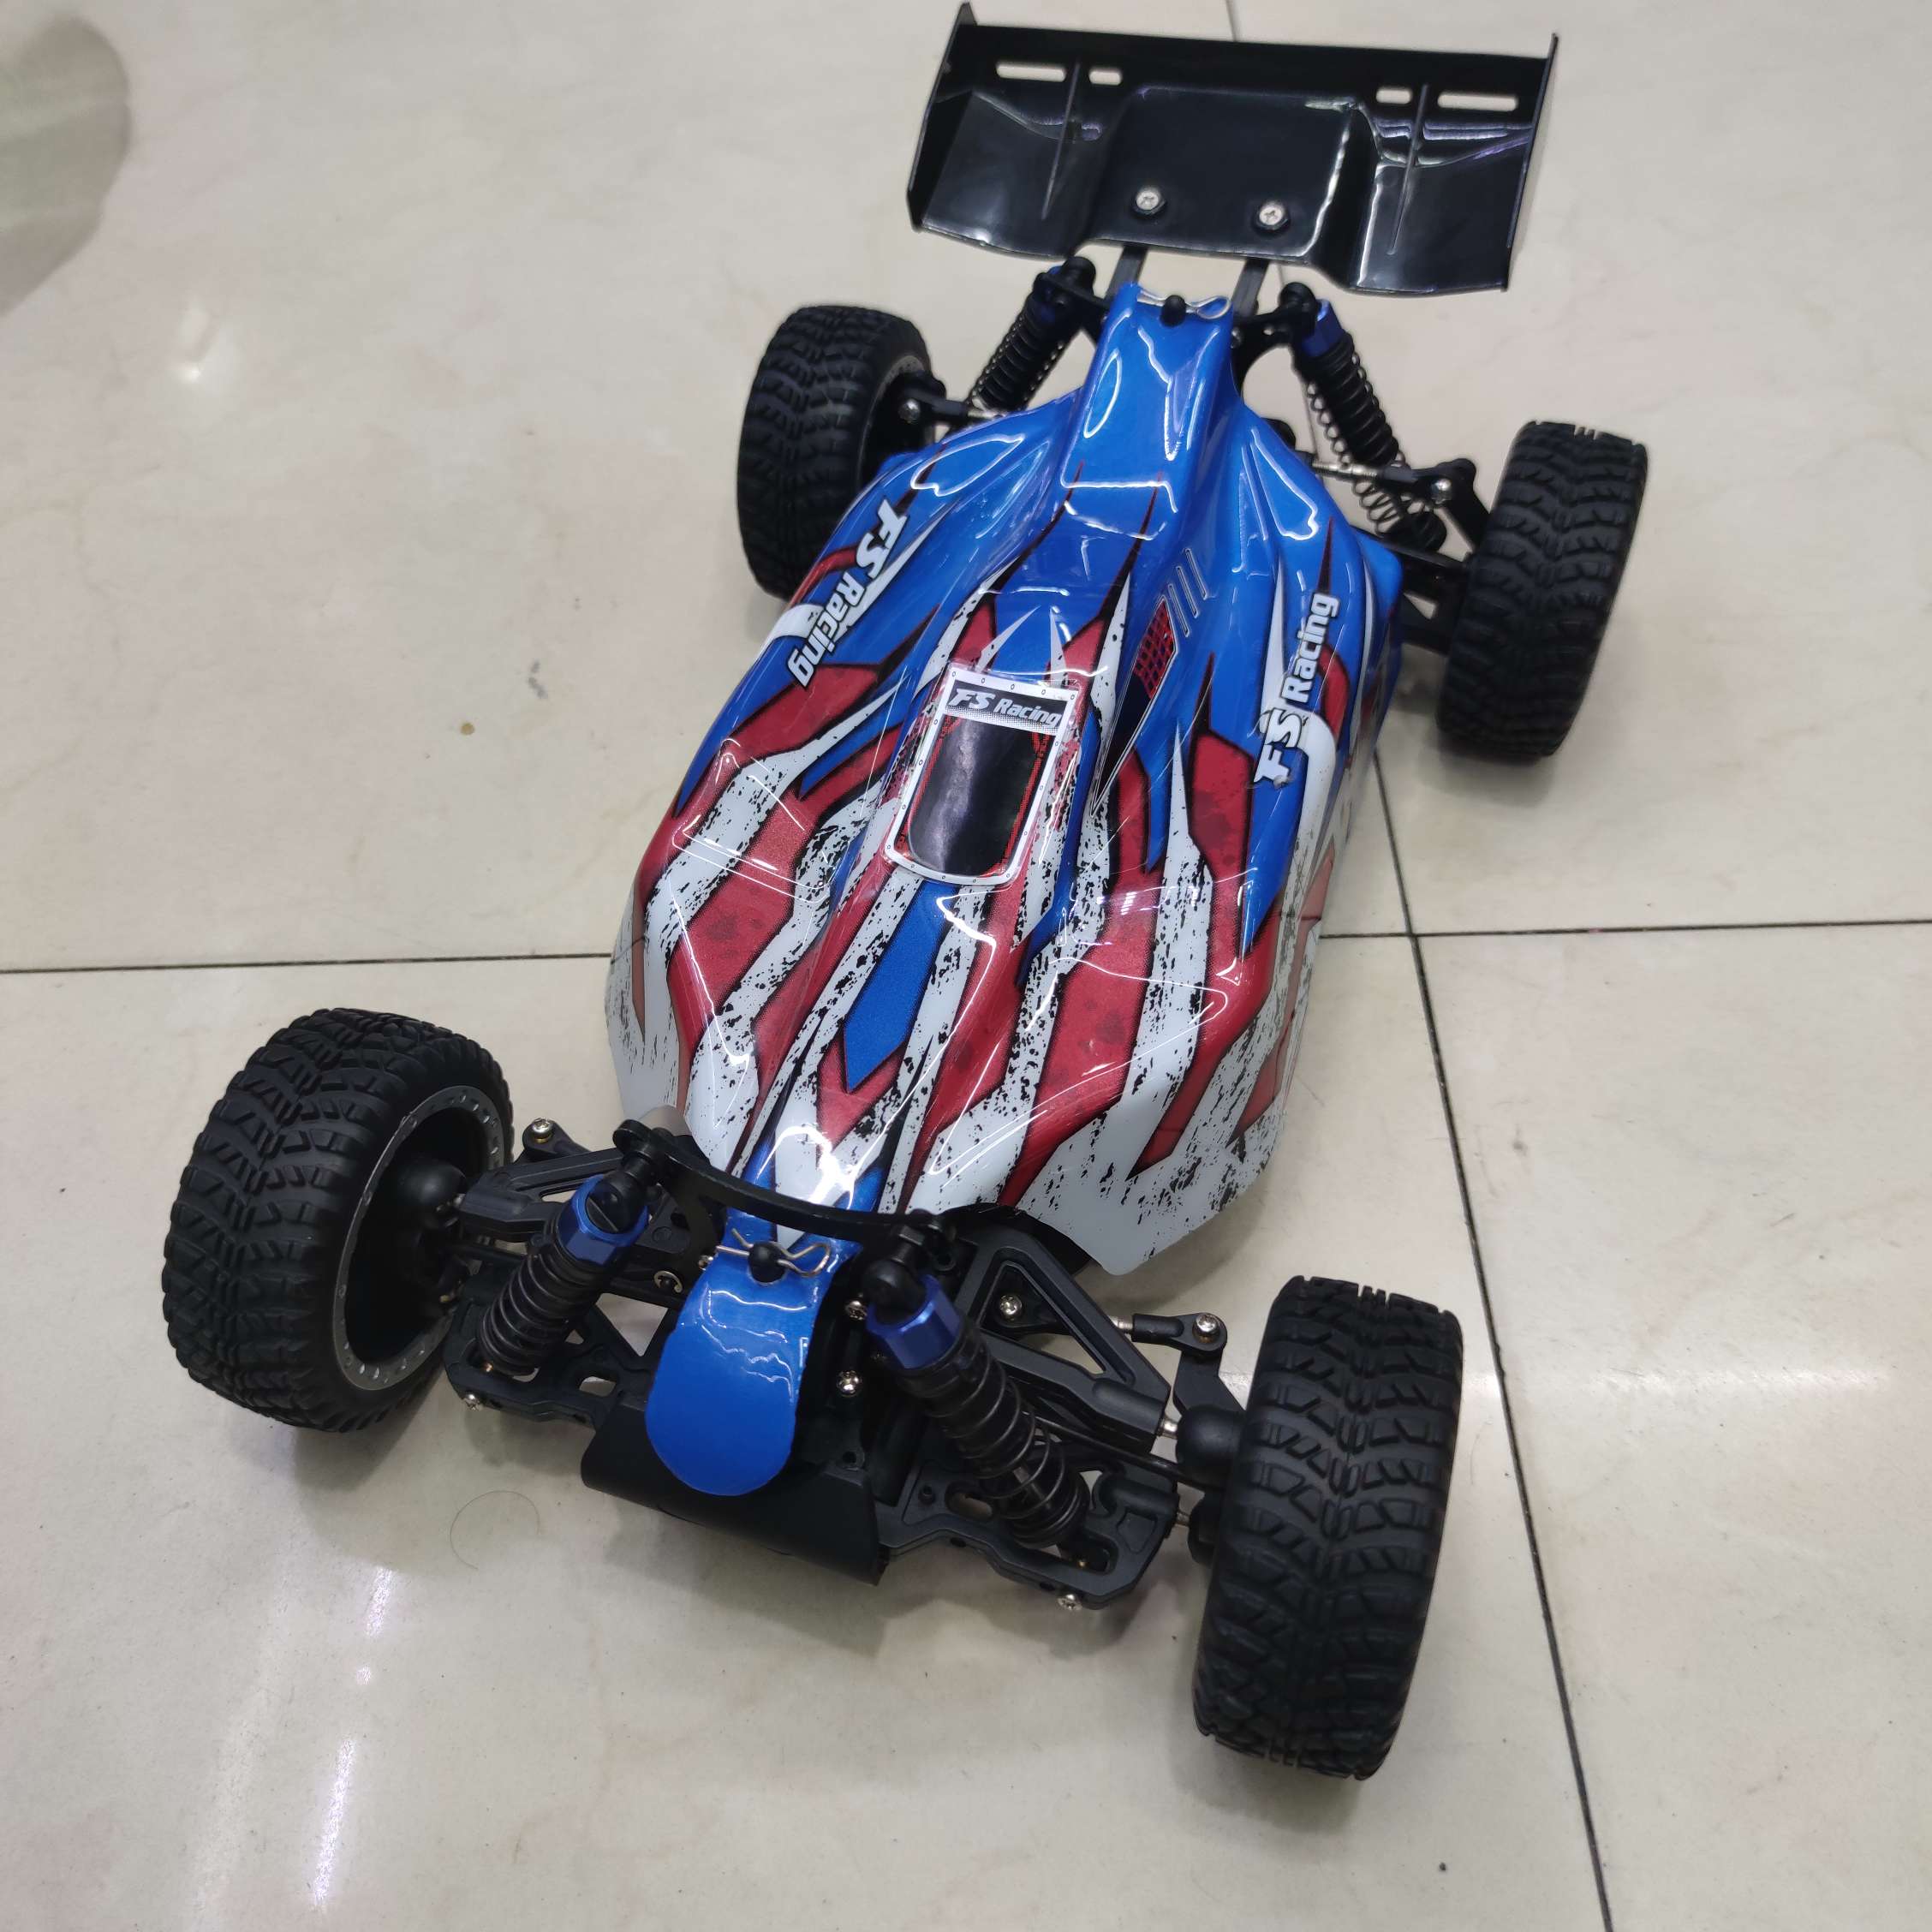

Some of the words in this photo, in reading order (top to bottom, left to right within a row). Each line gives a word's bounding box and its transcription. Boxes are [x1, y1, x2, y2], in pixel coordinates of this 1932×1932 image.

[856, 498, 909, 580] FS
[786, 571, 866, 688] Racing
[948, 688, 997, 710] FS
[993, 697, 1063, 726] Racing
[1253, 707, 1303, 789] FS
[1280, 593, 1340, 705] Racing
